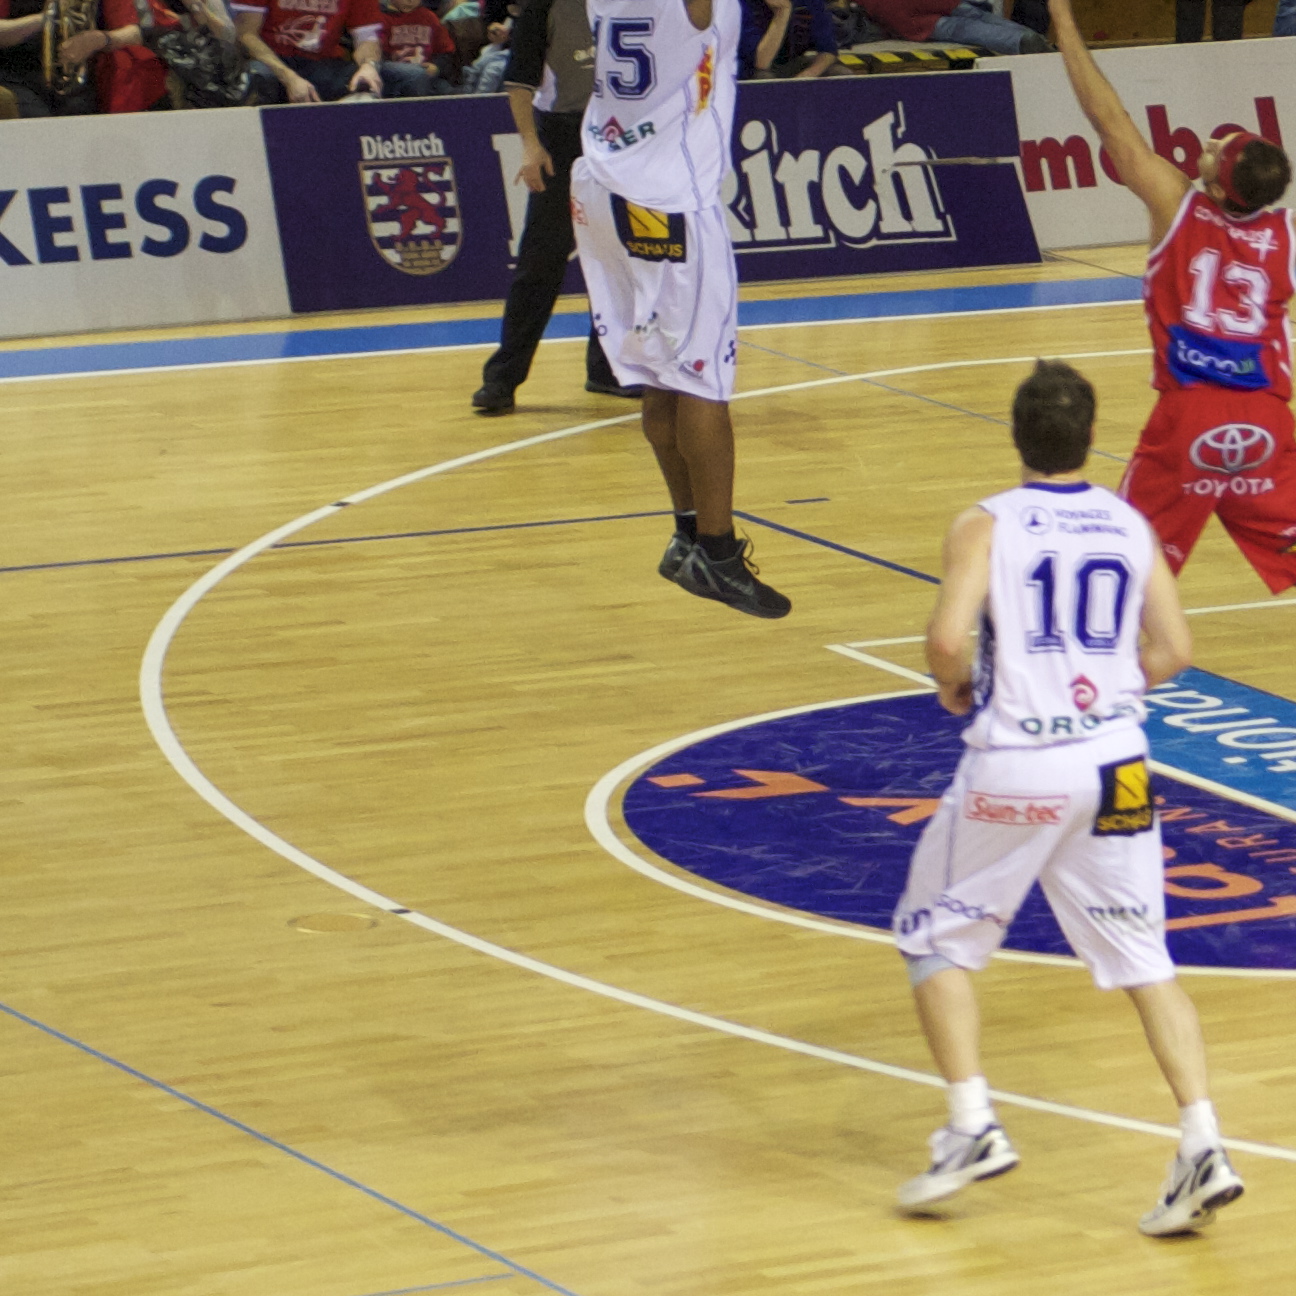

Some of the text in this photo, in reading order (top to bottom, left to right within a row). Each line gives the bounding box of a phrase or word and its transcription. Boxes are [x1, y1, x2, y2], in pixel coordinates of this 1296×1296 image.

[359, 133, 445, 162] Diekirch
[1182, 247, 1270, 337] 13
[1181, 476, 1275, 498] TOYOTA
[1025, 550, 1136, 654] 10
